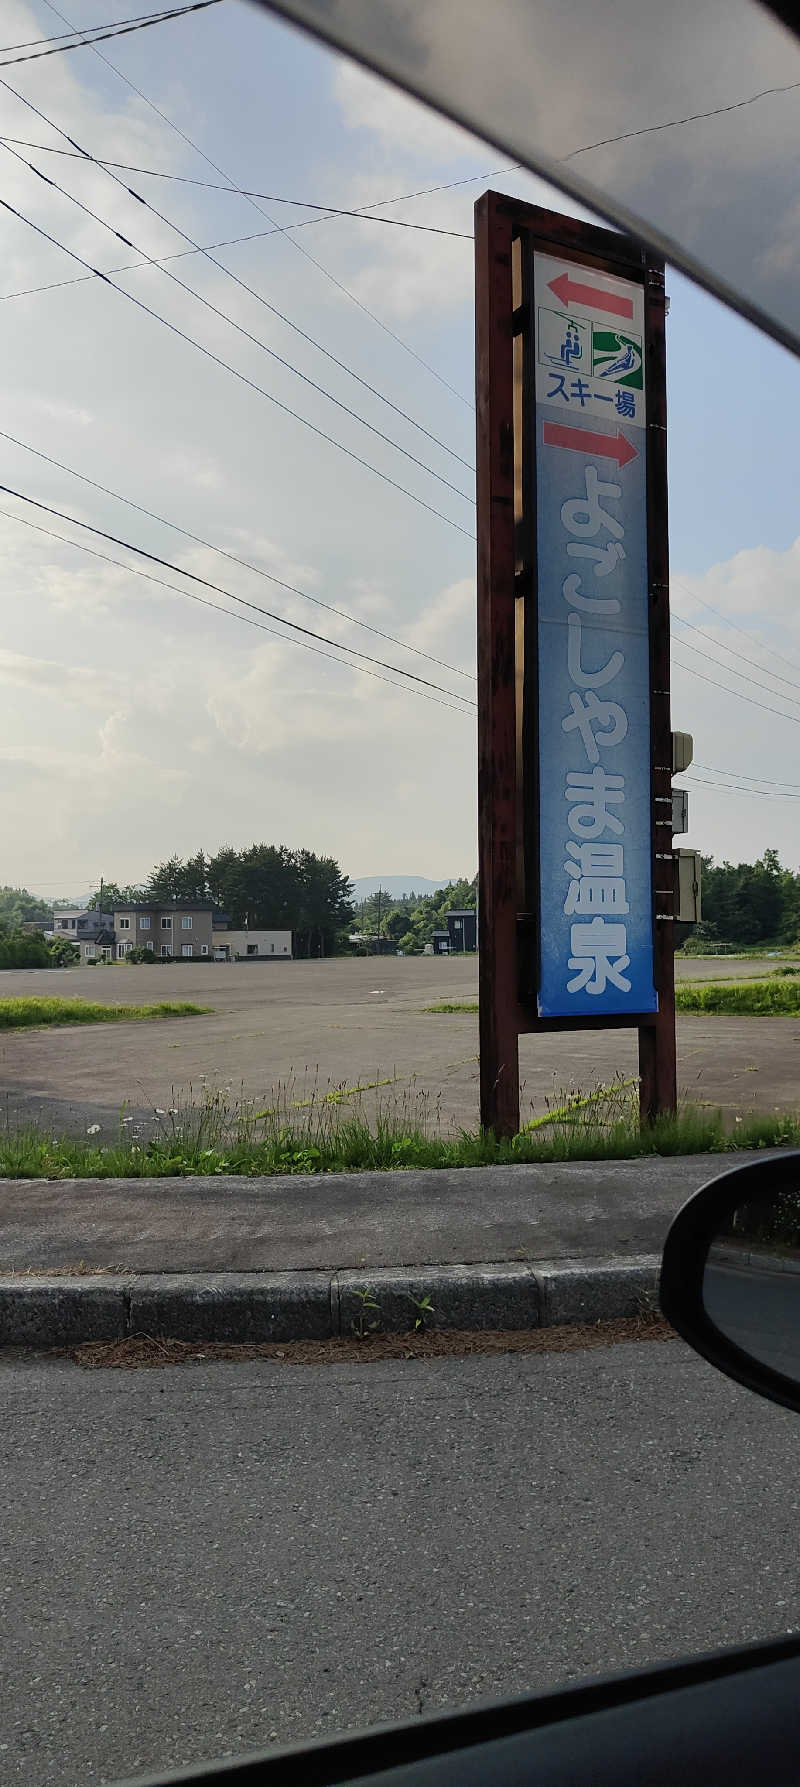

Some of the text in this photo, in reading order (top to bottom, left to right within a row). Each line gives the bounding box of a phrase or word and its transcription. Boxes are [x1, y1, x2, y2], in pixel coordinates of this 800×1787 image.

[547, 372, 636, 418] スキー場
[560, 464, 632, 995] よごしやま温泉
